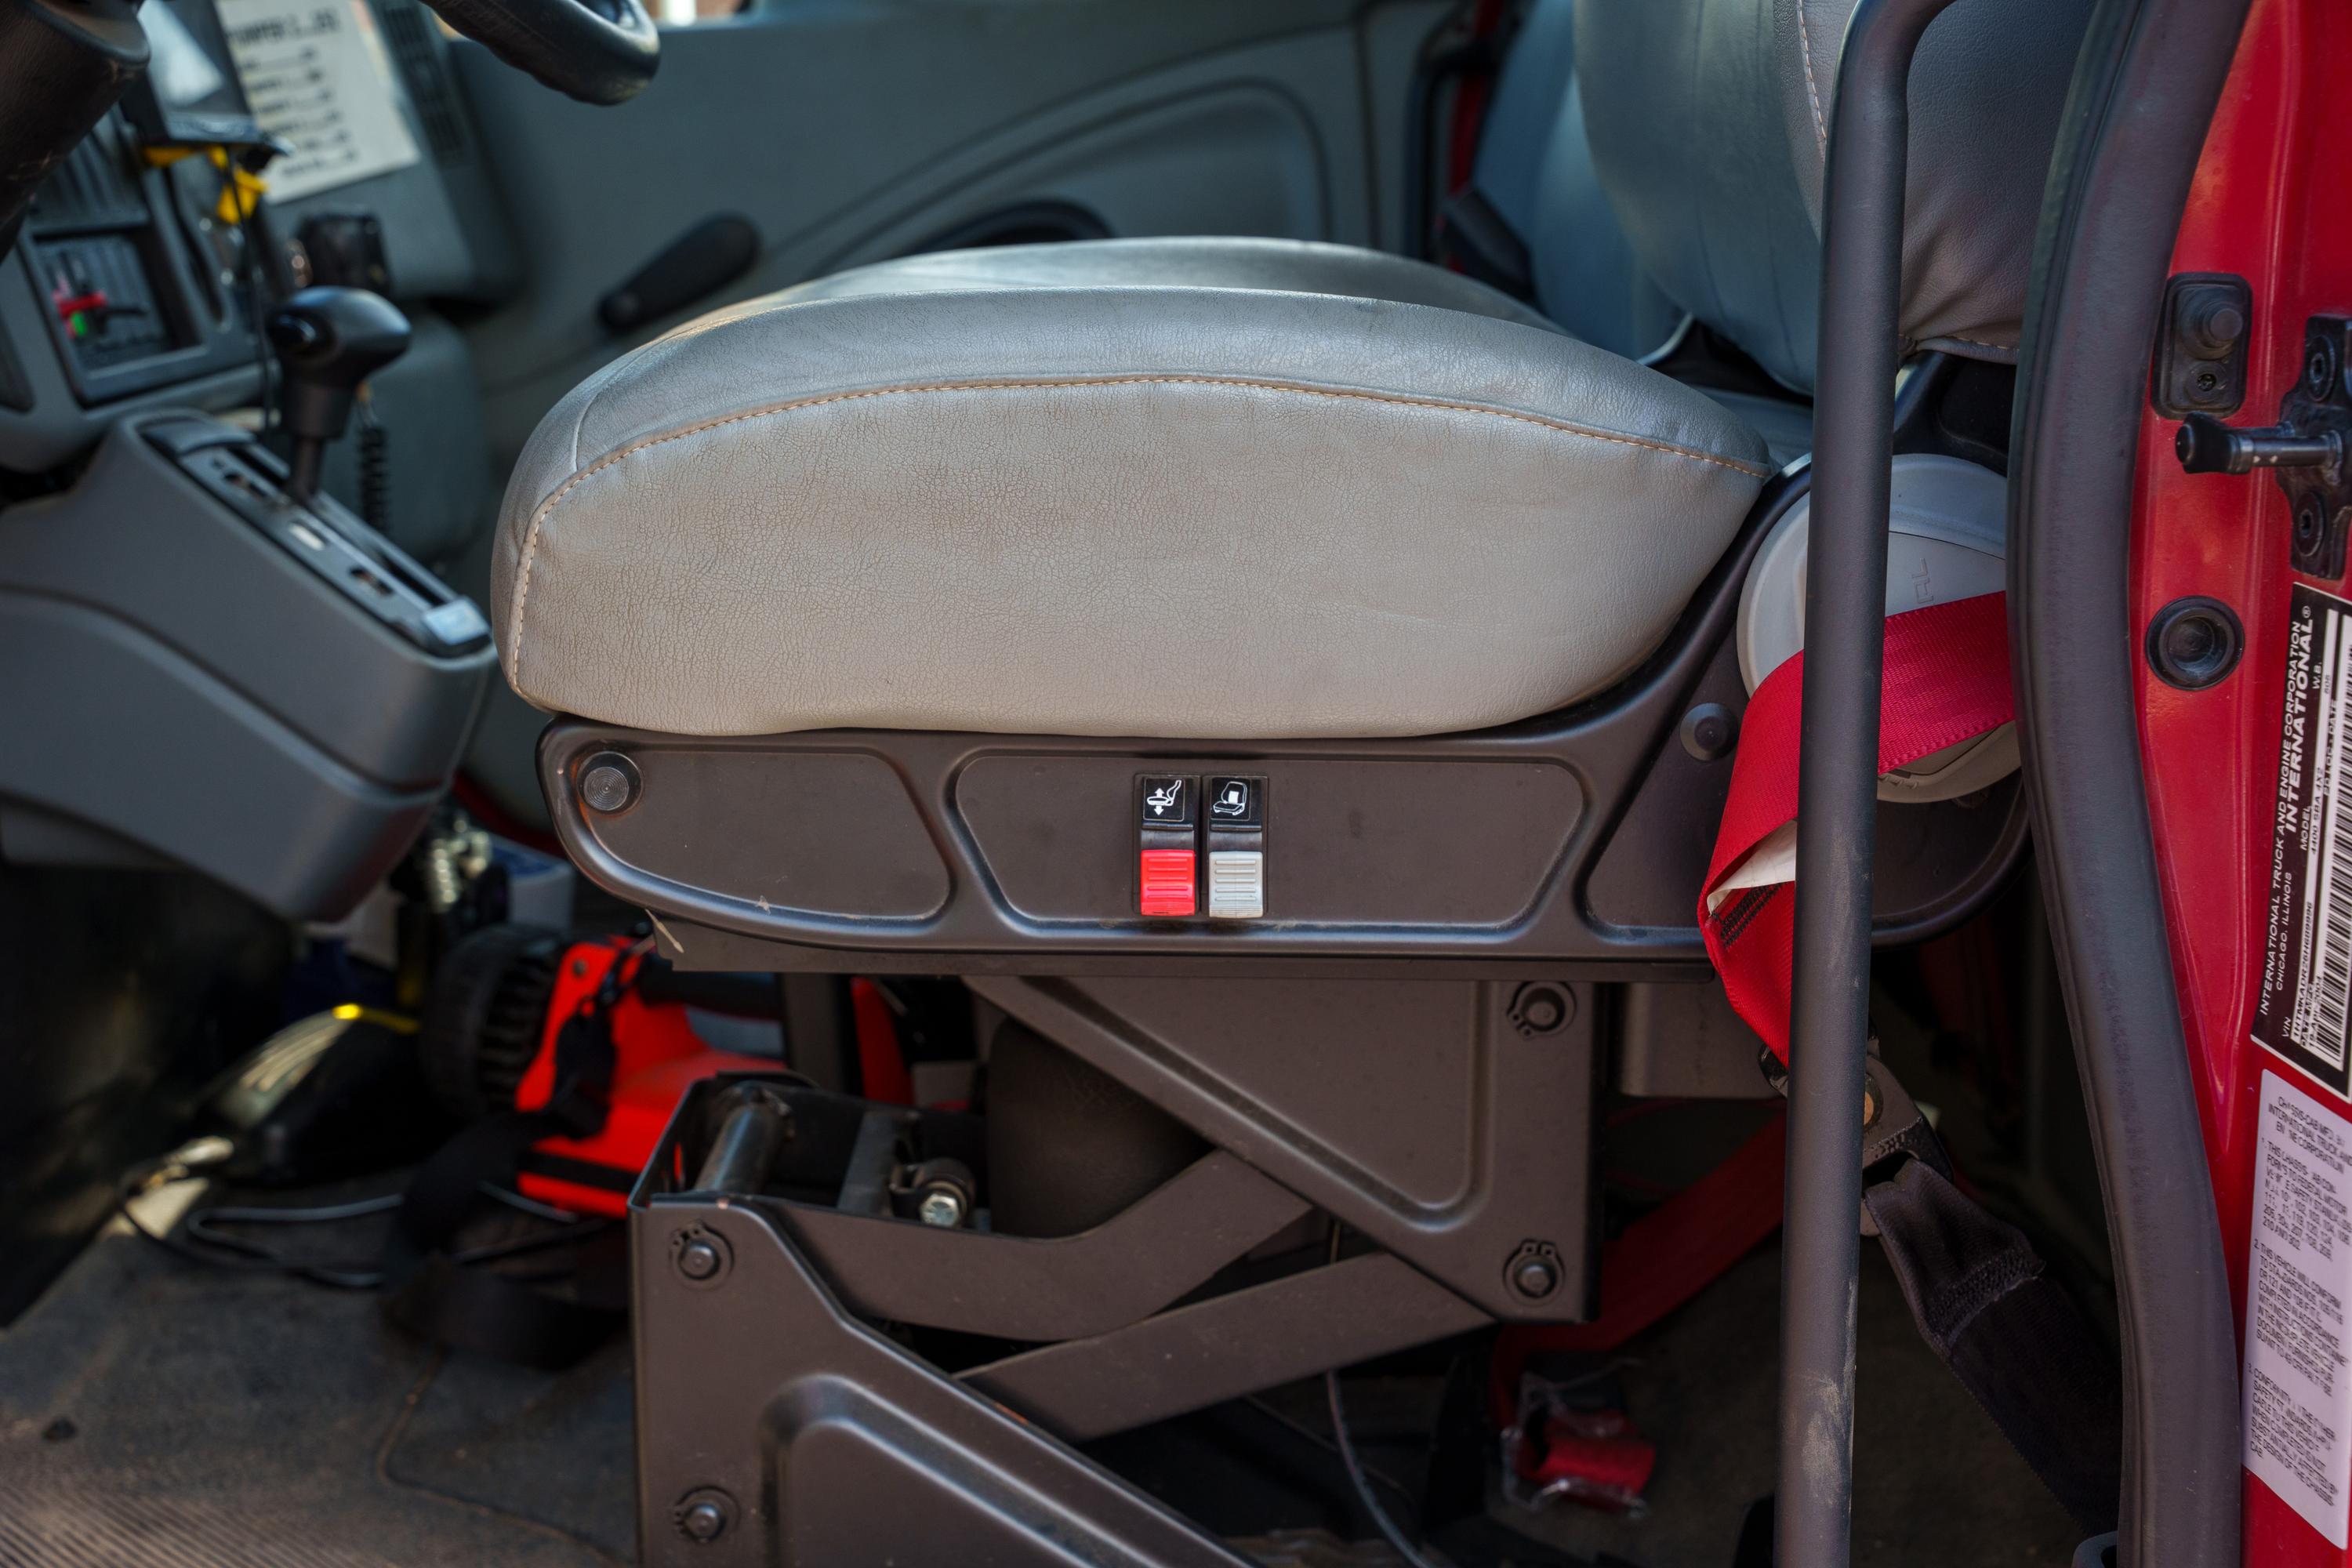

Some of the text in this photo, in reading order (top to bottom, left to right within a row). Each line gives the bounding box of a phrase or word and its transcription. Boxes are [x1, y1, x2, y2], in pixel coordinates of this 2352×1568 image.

[2260, 620, 2300, 1014] INTERNATIONAL TRUCK AND ENGINE CORPORATION
[2300, 805, 2310, 851] MODEL
[2276, 872, 2292, 991] CHICAGO, ILLINOIS
[2282, 1016, 2291, 1037] VIN
